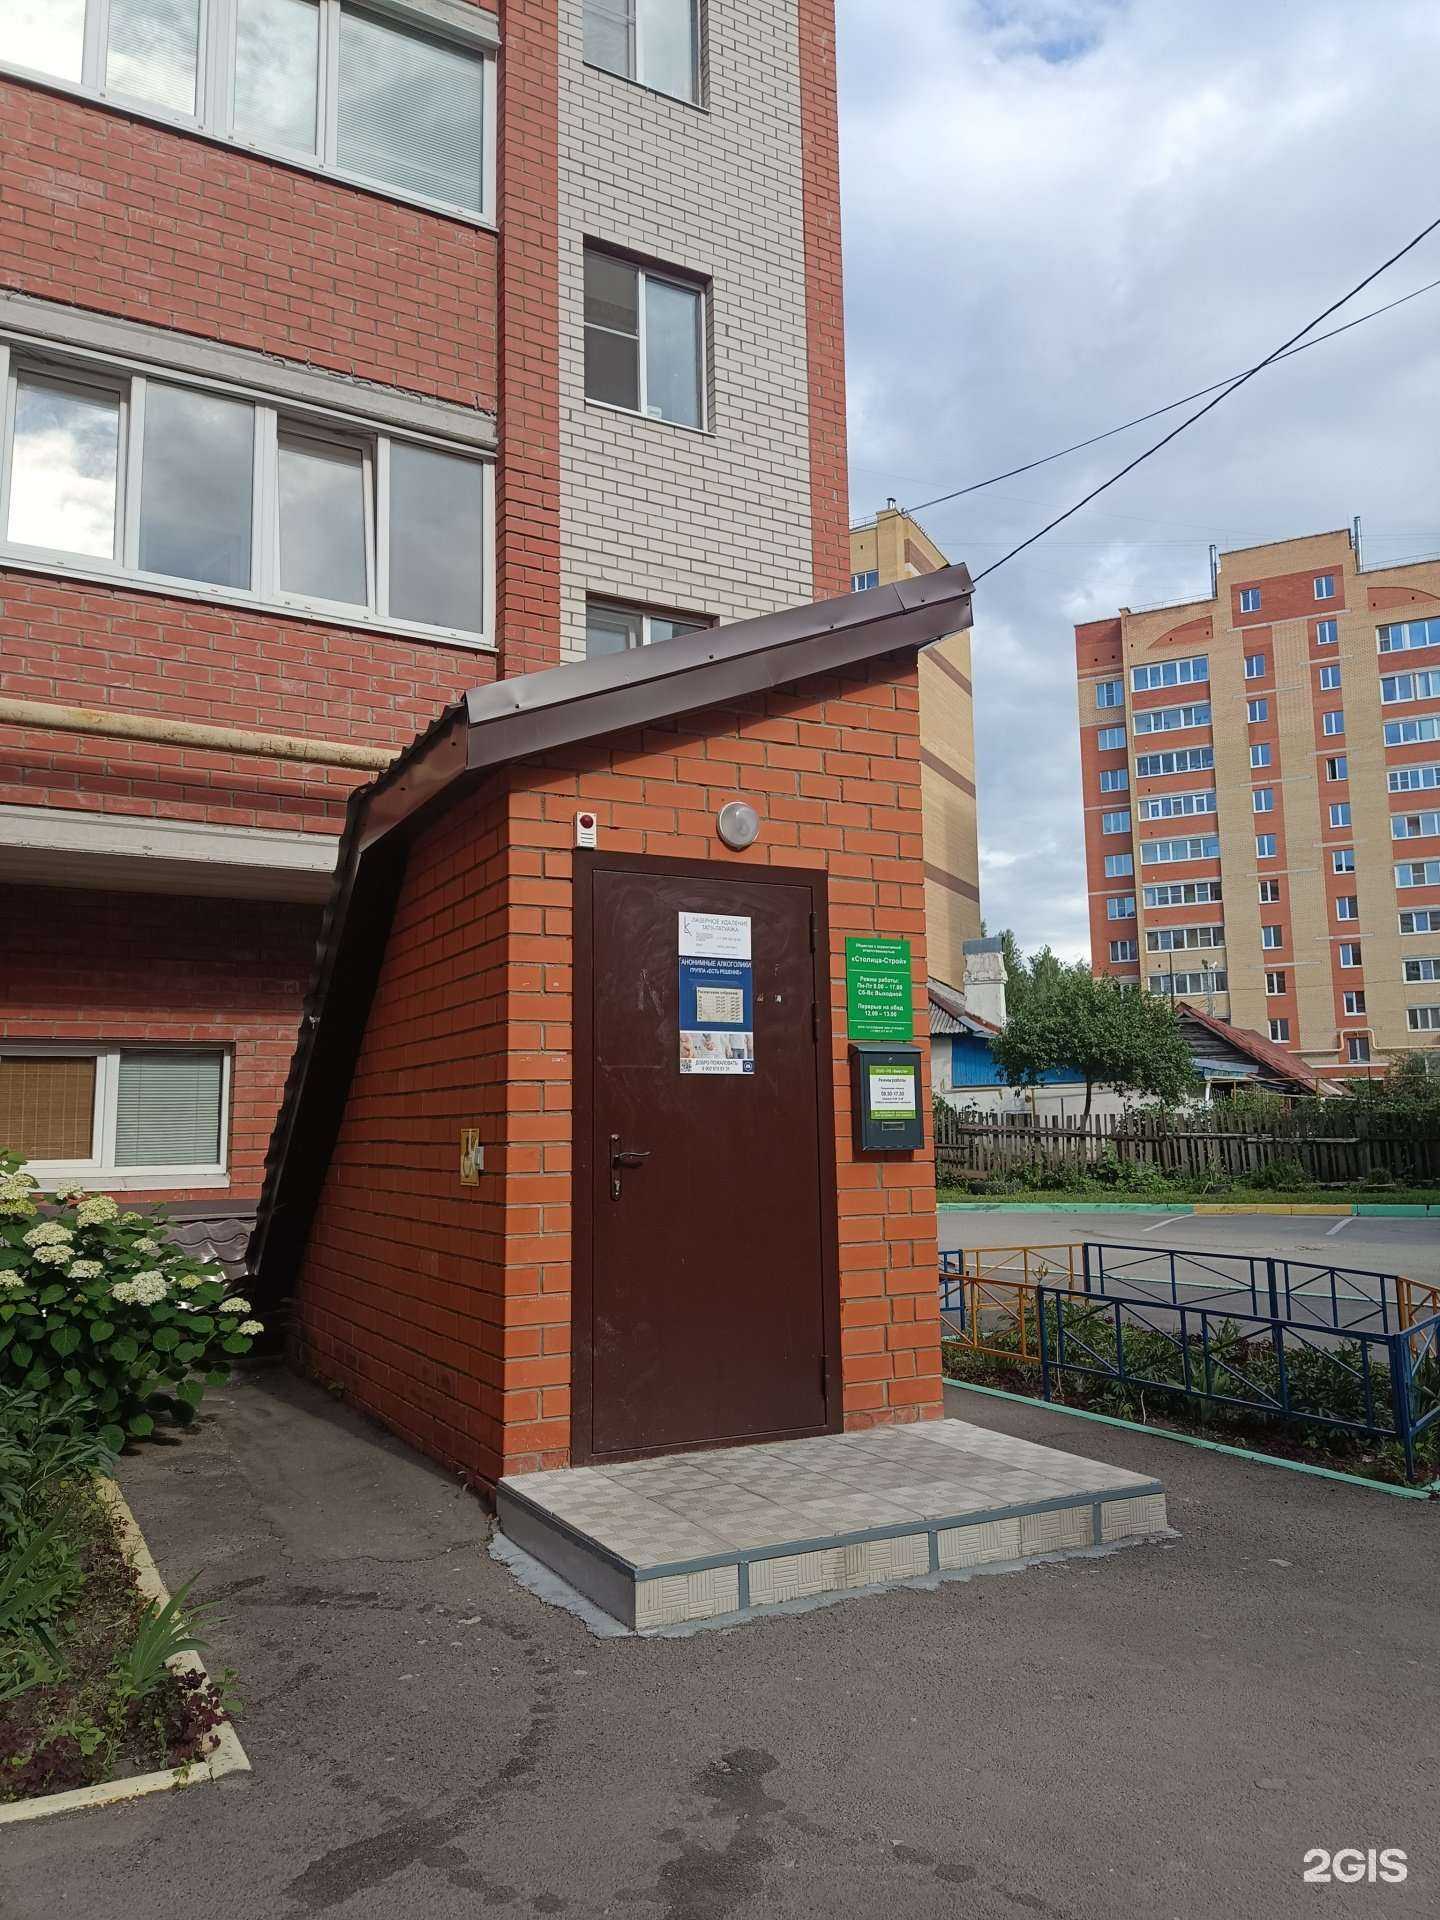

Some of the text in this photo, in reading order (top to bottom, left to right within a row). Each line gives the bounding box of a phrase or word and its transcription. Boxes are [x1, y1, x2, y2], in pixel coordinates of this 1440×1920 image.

[681, 959, 752, 969] АНОНИМНЫЕ АЛКОГОЛИКИ
[851, 955, 907, 965] «Столица-Строй»
